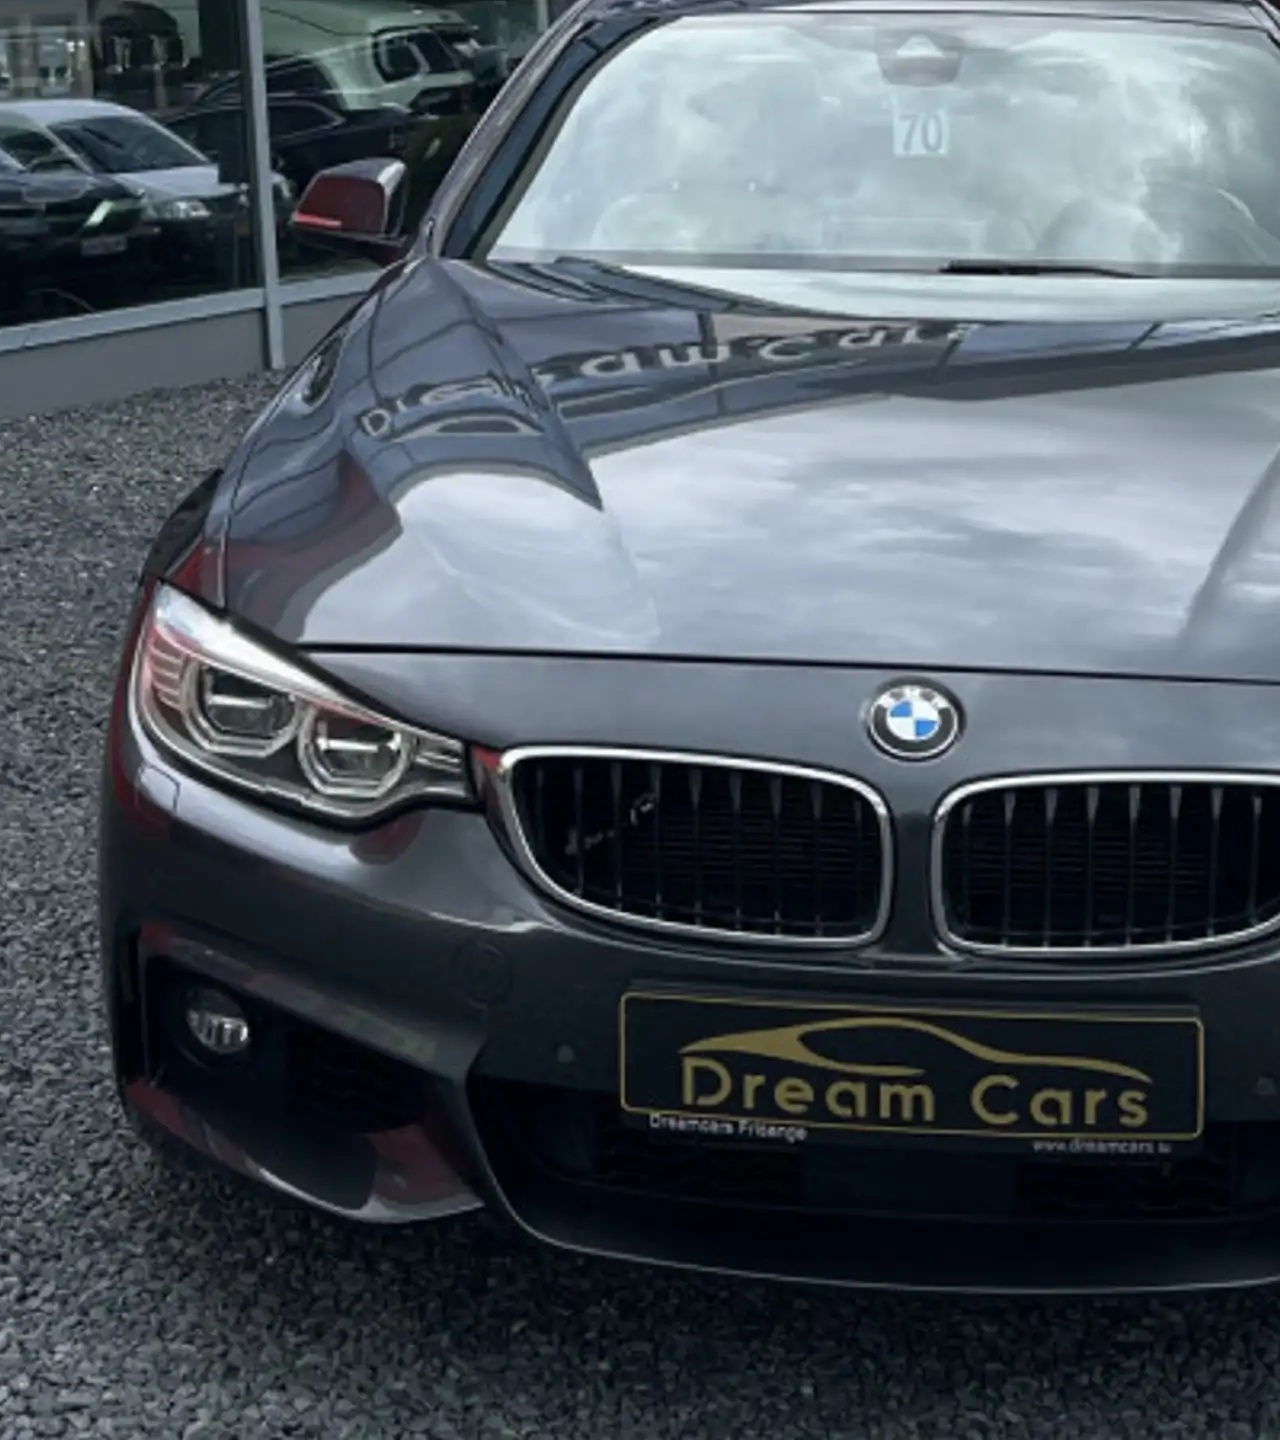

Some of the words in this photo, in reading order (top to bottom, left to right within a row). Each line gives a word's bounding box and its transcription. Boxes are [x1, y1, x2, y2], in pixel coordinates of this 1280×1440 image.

[899, 113, 943, 153] 70
[681, 1056, 936, 1122] Dream
[971, 1074, 1149, 1128] Cars
